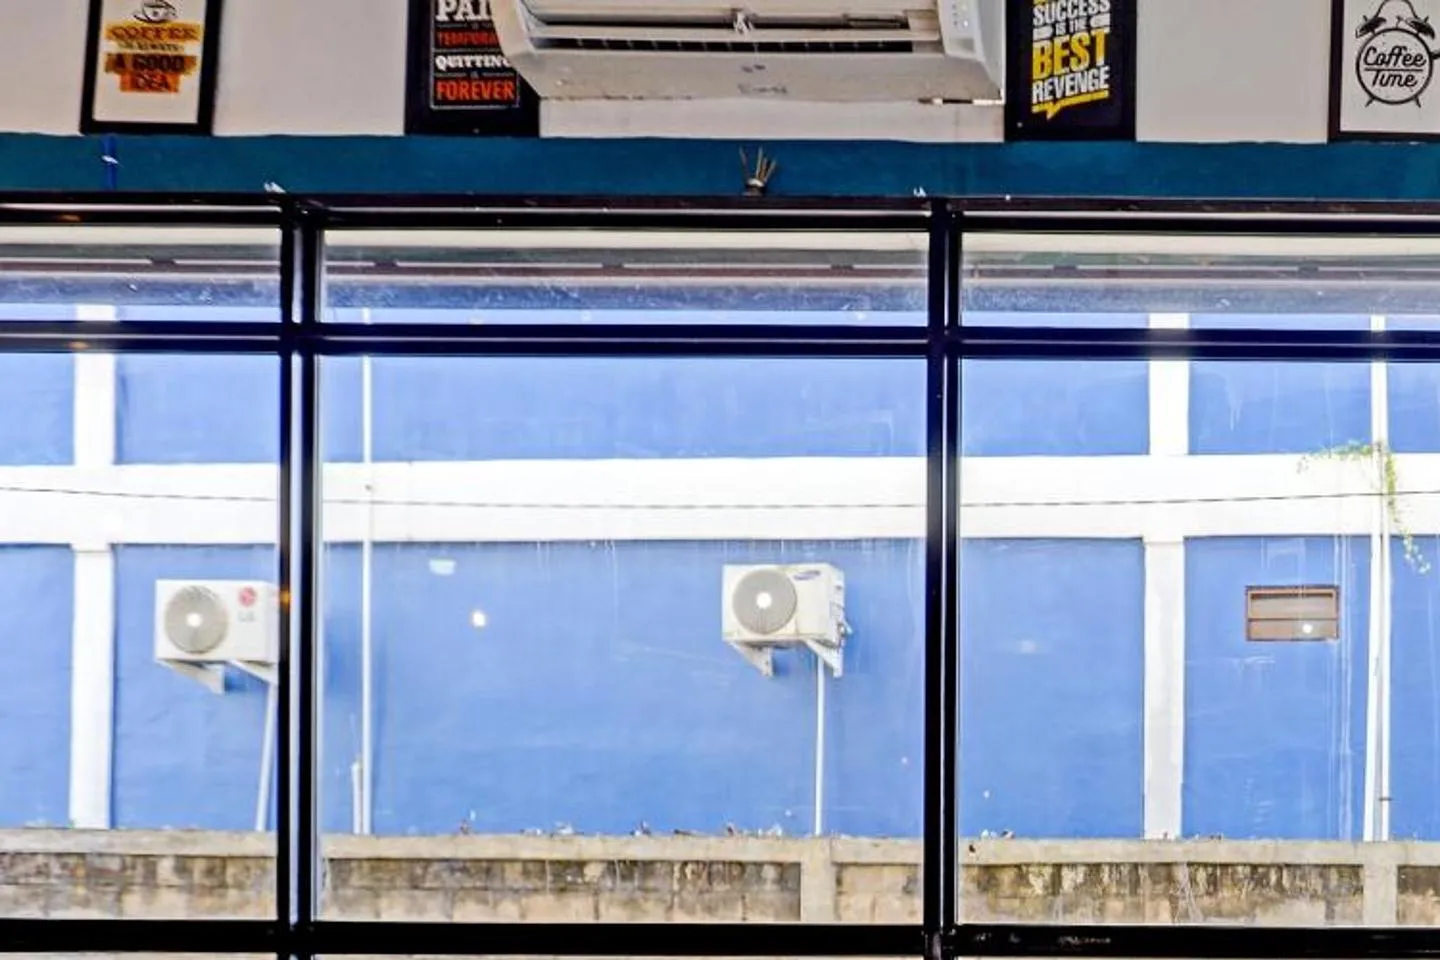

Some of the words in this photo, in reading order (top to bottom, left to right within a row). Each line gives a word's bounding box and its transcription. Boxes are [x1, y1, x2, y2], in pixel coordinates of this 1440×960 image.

[435, 0, 492, 21] PAI
[1032, 0, 1111, 26] SUCCESS
[1055, 22, 1066, 35] IS
[1032, 28, 1110, 80] BEST
[1363, 45, 1427, 67] Coffee
[1032, 66, 1110, 104] REVENGE
[1364, 69, 1418, 88] Time
[437, 80, 515, 100] FOREVER
